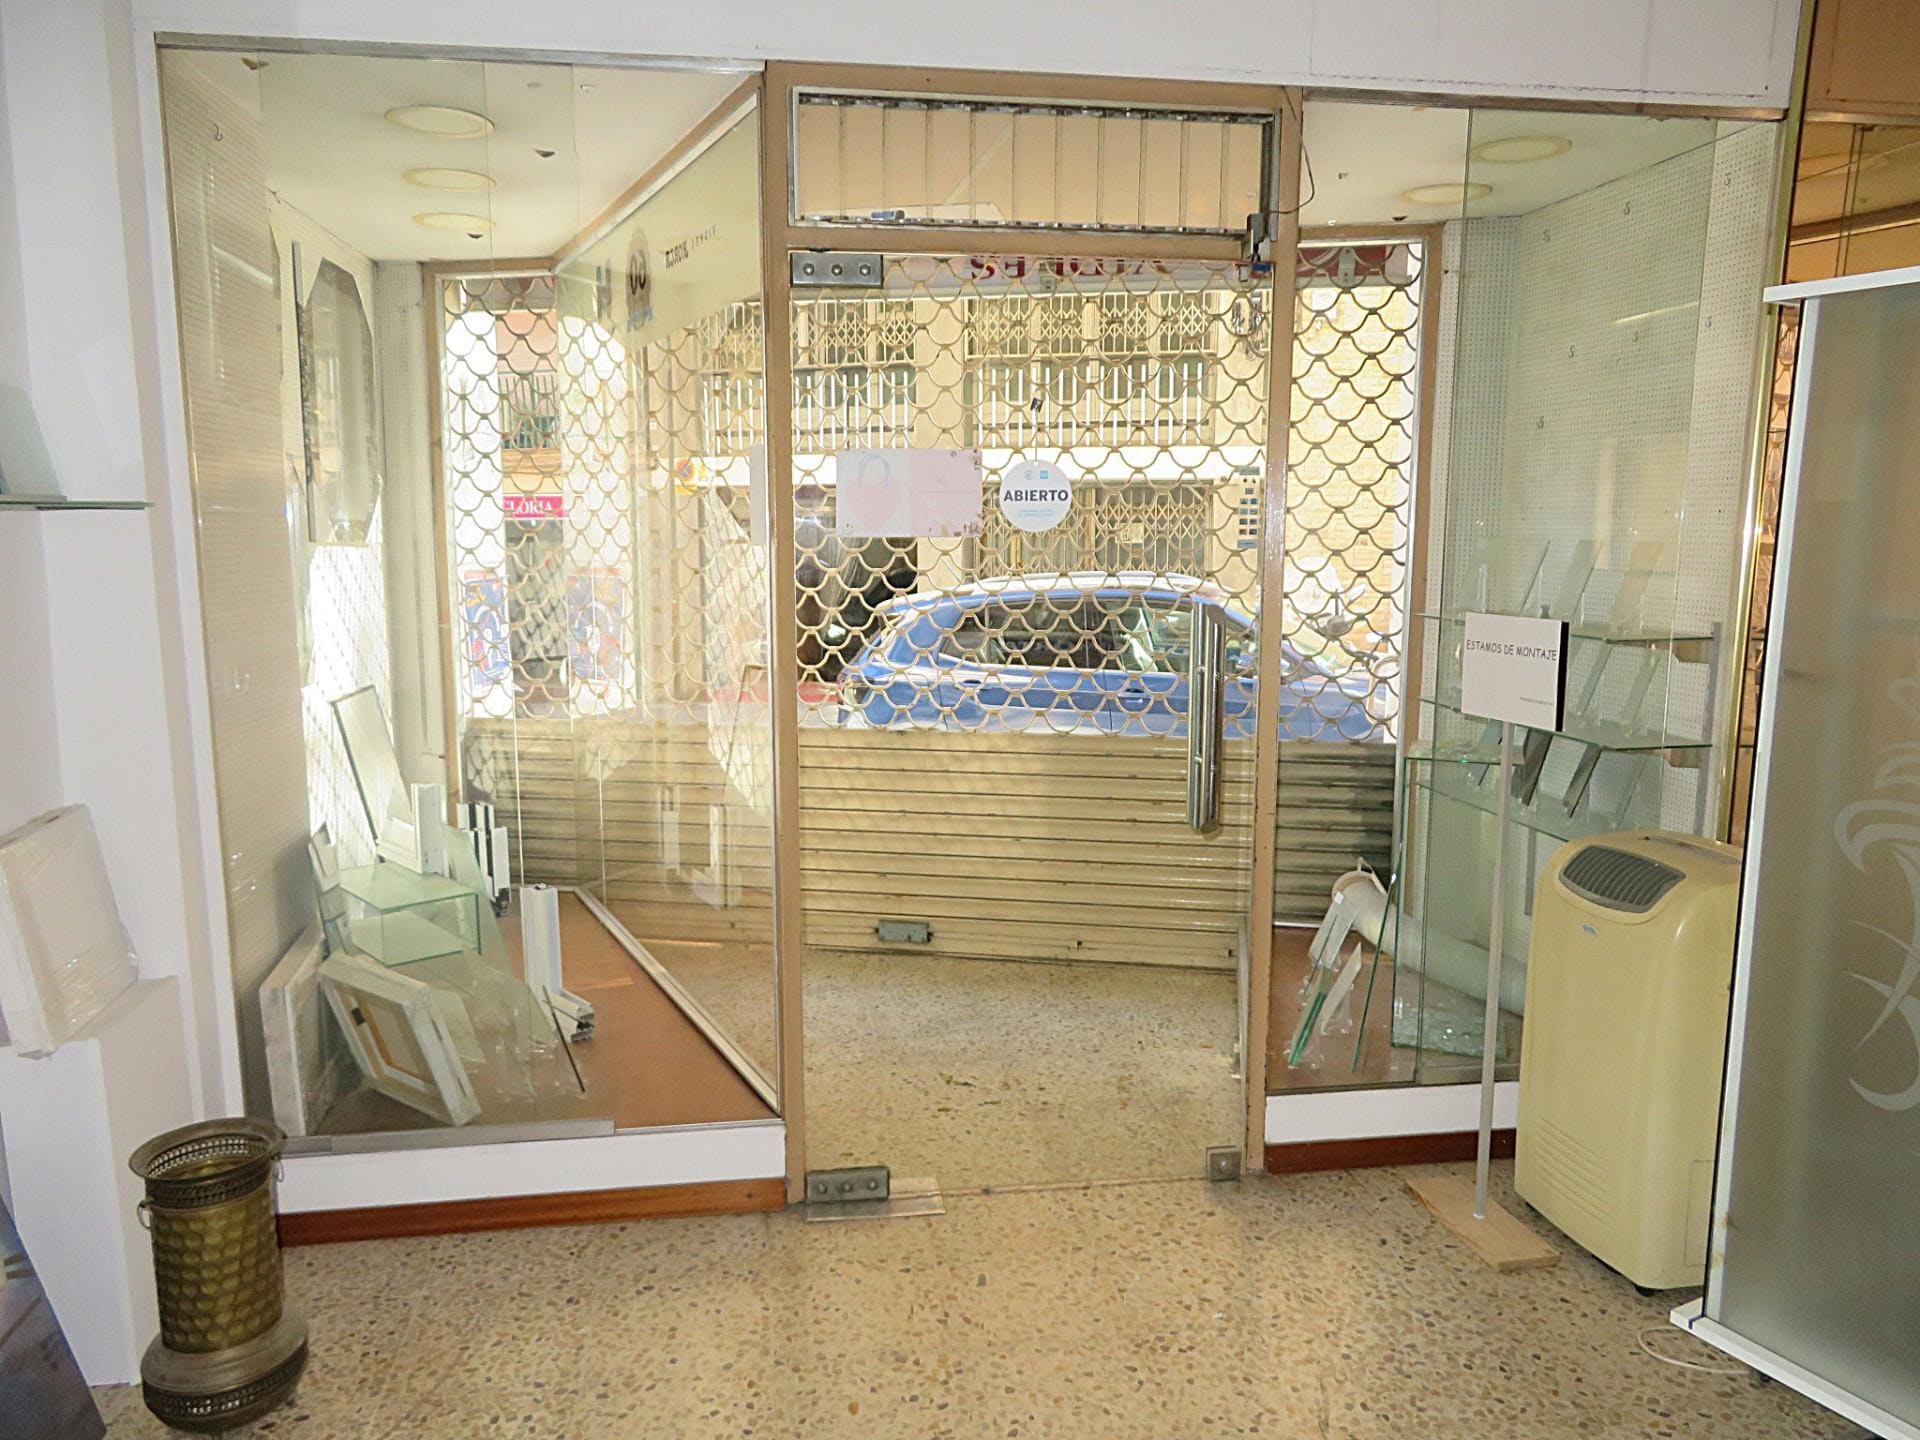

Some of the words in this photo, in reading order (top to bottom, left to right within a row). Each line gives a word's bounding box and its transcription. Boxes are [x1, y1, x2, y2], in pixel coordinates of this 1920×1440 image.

[1003, 489, 1069, 502] ABIERTO
[1466, 639, 1502, 654] ESTAMOS
[1503, 644, 1514, 656] DE
[1516, 645, 1558, 661] MONTAJE
